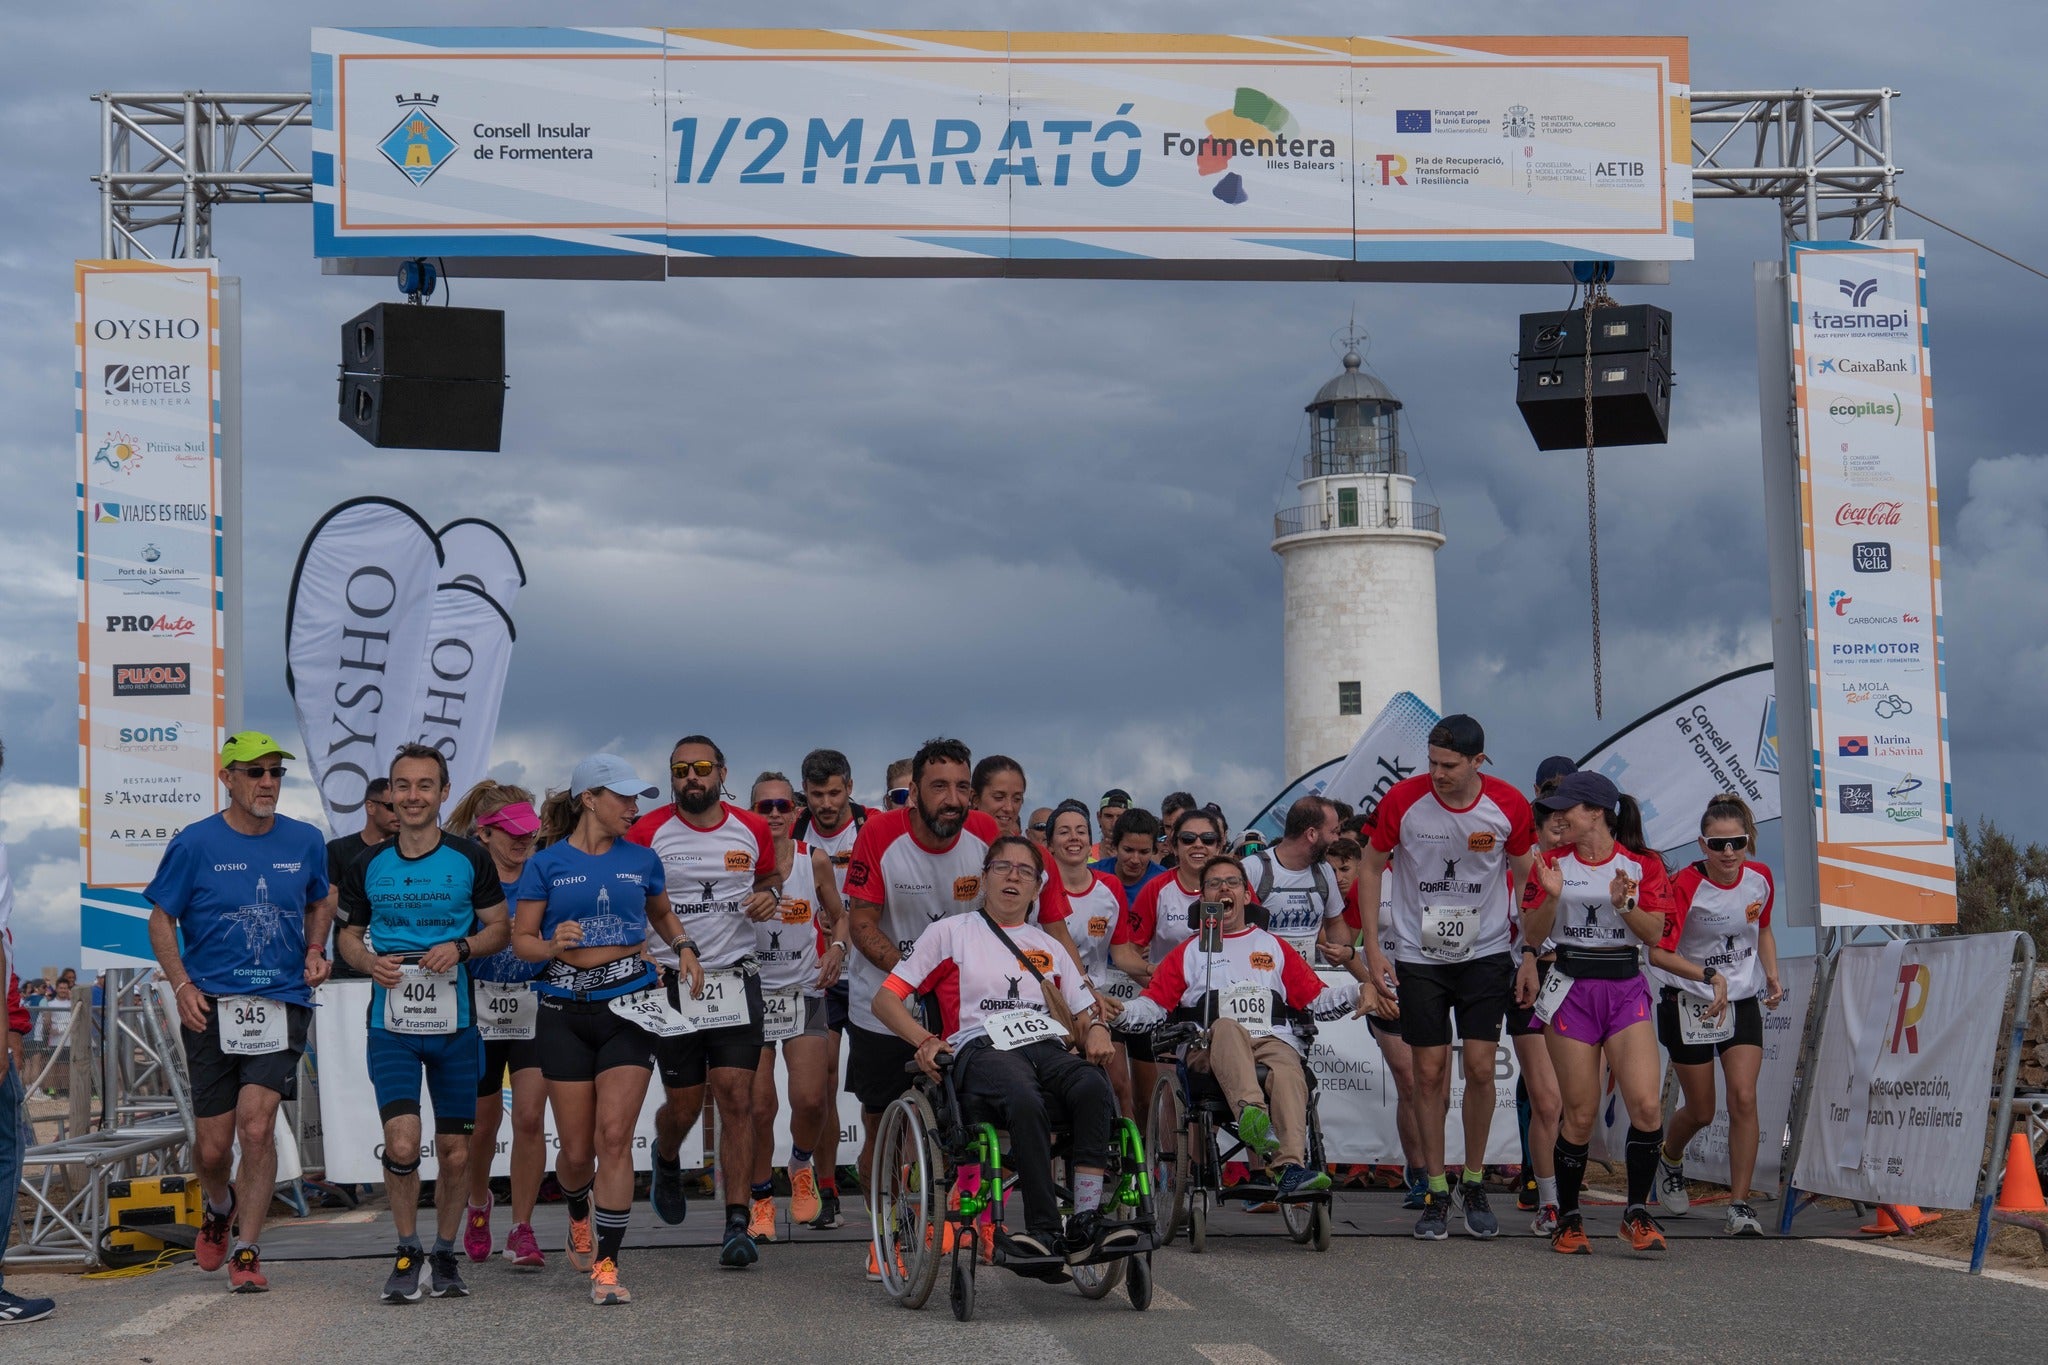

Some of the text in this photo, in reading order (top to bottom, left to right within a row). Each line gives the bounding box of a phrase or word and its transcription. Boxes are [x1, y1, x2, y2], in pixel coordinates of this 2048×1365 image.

[1434, 109, 1478, 118] Finançat per
[1460, 118, 1491, 126] Europea
[473, 122, 591, 139] Consell Insular
[671, 103, 1142, 188] 1/2 MARATÓ
[1163, 132, 1336, 158] Formentera
[473, 144, 594, 161] de Formentera
[1267, 160, 1335, 170] Illes Balears
[1415, 157, 1504, 166] Pla de Recuperació,
[1415, 167, 1479, 175] Transformació
[1595, 162, 1644, 176] AETIB
[1421, 177, 1469, 185] Resiliència
[1812, 309, 1908, 331] trasmapi
[94, 317, 200, 340] OYSHO
[1838, 358, 1908, 373] CaixaBank
[131, 364, 191, 381] emar
[131, 381, 191, 394] HOTELS
[104, 398, 191, 406] FORMENTERA
[1829, 402, 1895, 418] ecopilas
[184, 441, 205, 452] Sud
[121, 503, 207, 522] VIAJES ES FREUS
[1856, 545, 1888, 558] Font
[1856, 557, 1889, 570] Vella
[118, 568, 135, 576] Port
[149, 567, 157, 575] la
[158, 567, 185, 575] Savina
[1902, 613, 1920, 624] tur
[1833, 643, 1920, 655] FORMOTOR
[117, 666, 187, 684] PUJOLS
[321, 565, 397, 814] OYSHO
[1842, 682, 1890, 691] LA MOLA
[418, 638, 474, 762] SHO
[1675, 716, 1692, 736] de
[119, 726, 178, 743] sons
[1874, 734, 1911, 745] Marina
[1692, 704, 1763, 802] Consell Insular
[1888, 746, 1923, 757] Savina
[123, 777, 182, 785] RESTAURANT
[1886, 807, 1923, 819] Dulcesol
[214, 862, 247, 872] OYSHO
[553, 875, 587, 887] OYSHO
[372, 893, 401, 903] CURSA
[1437, 921, 1464, 937] 320
[251, 976, 271, 984] 2023
[403, 983, 436, 1002] 404
[1108, 983, 1134, 999] 408
[489, 997, 519, 1013] 409
[631, 1001, 663, 1015] 365
[707, 1004, 719, 1013] Edu
[1229, 998, 1266, 1014] 1068
[234, 1006, 266, 1025] 345
[702, 1012, 741, 1024] trasmapi
[406, 1019, 448, 1029] trasmapi
[493, 1026, 530, 1035] trasmapi
[1002, 1018, 1049, 1038] 1163
[242, 1029, 262, 1037] Javier
[240, 1039, 280, 1050] trasmapi
[1310, 1058, 1374, 1076] ONÒMIC,
